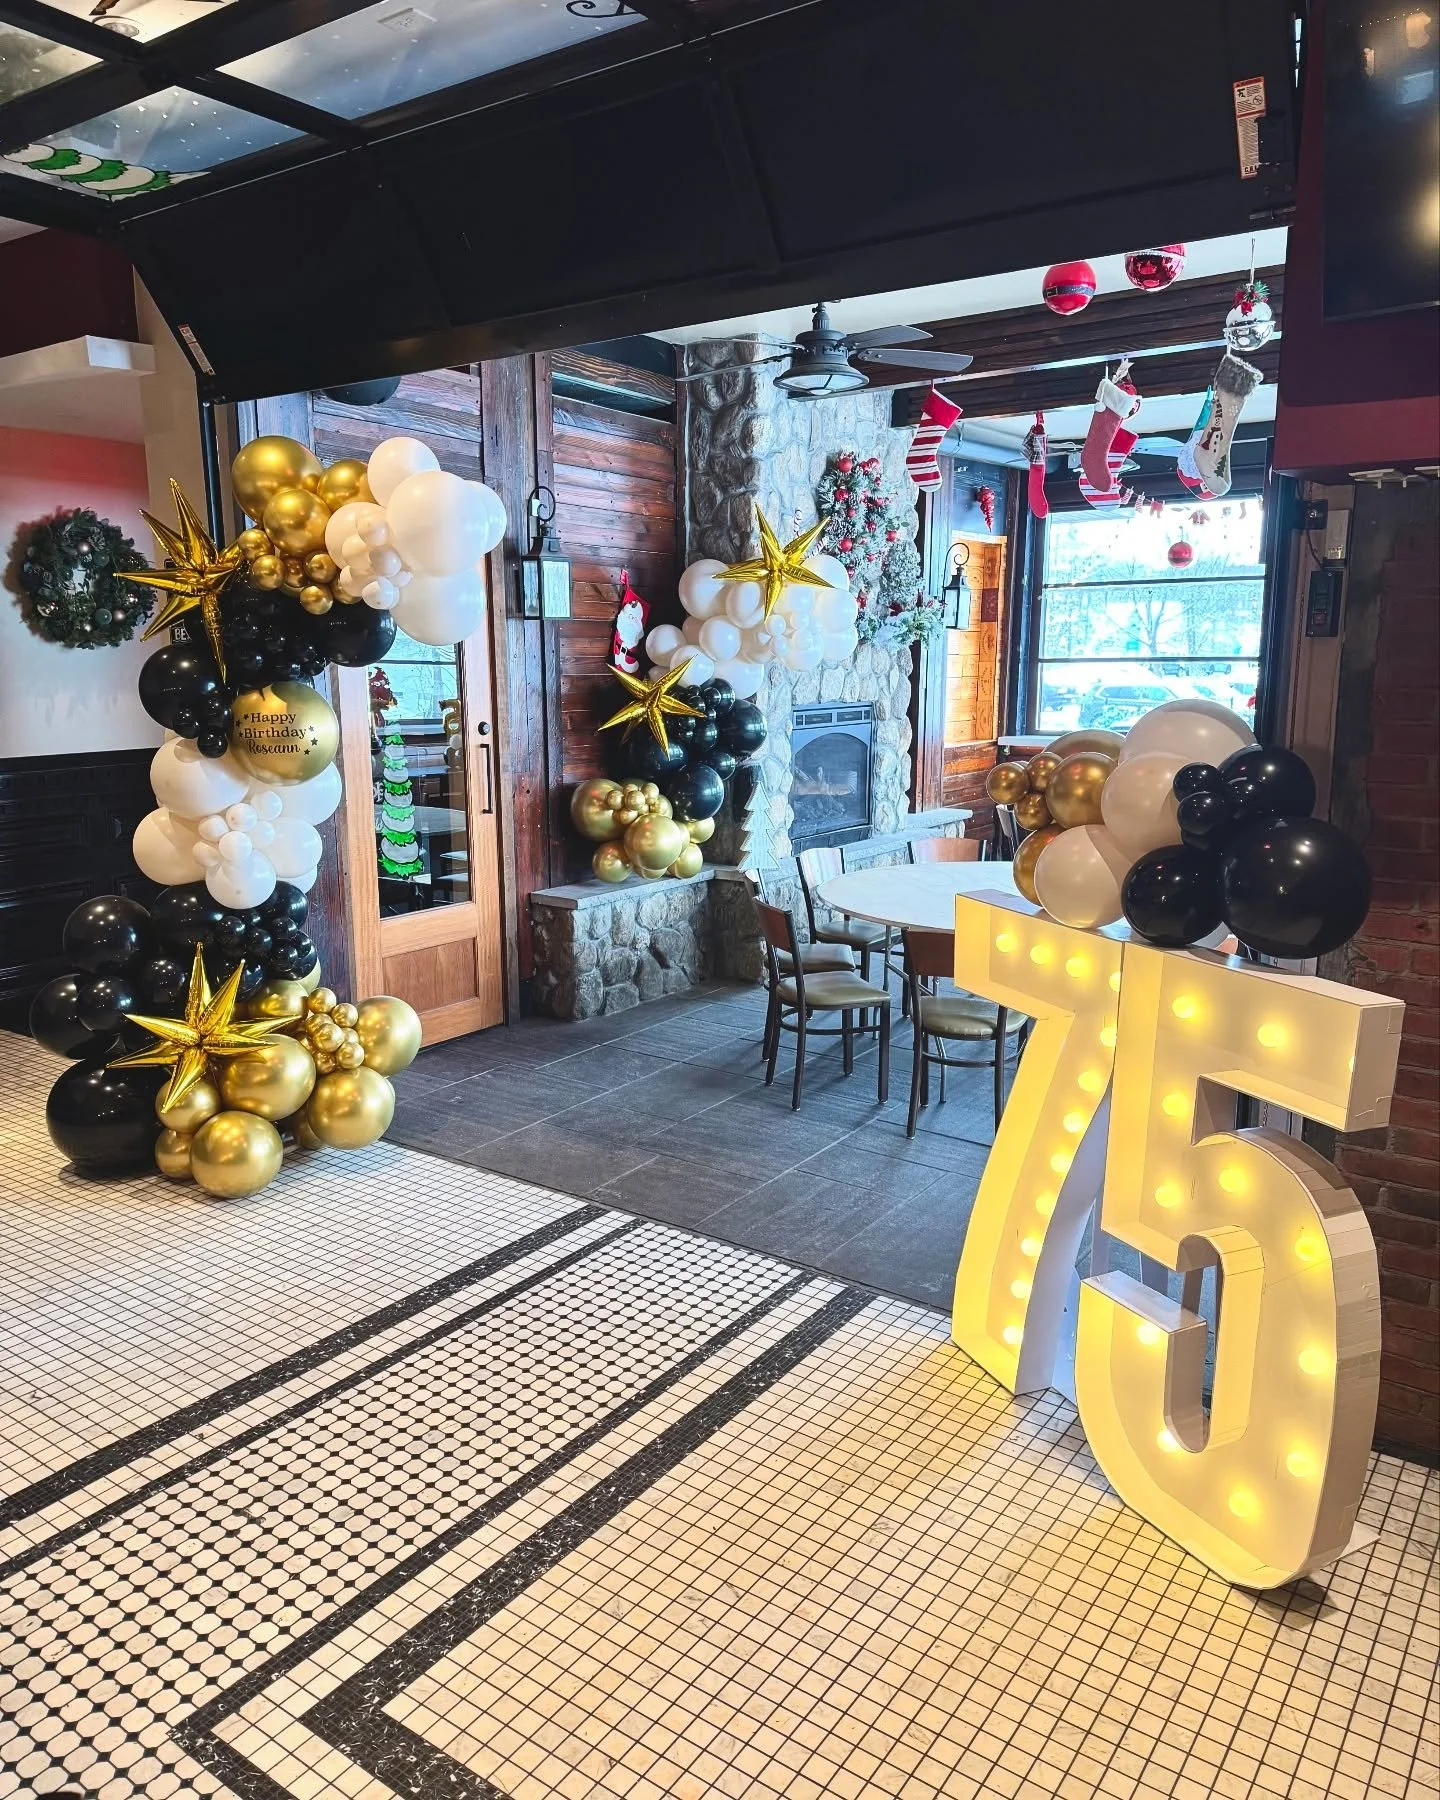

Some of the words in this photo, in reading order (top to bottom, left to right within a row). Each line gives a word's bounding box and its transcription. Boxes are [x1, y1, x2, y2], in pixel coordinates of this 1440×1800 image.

[250, 712, 297, 725] Happy
[243, 726, 307, 740] Birthday
[246, 739, 301, 755] Roseann
